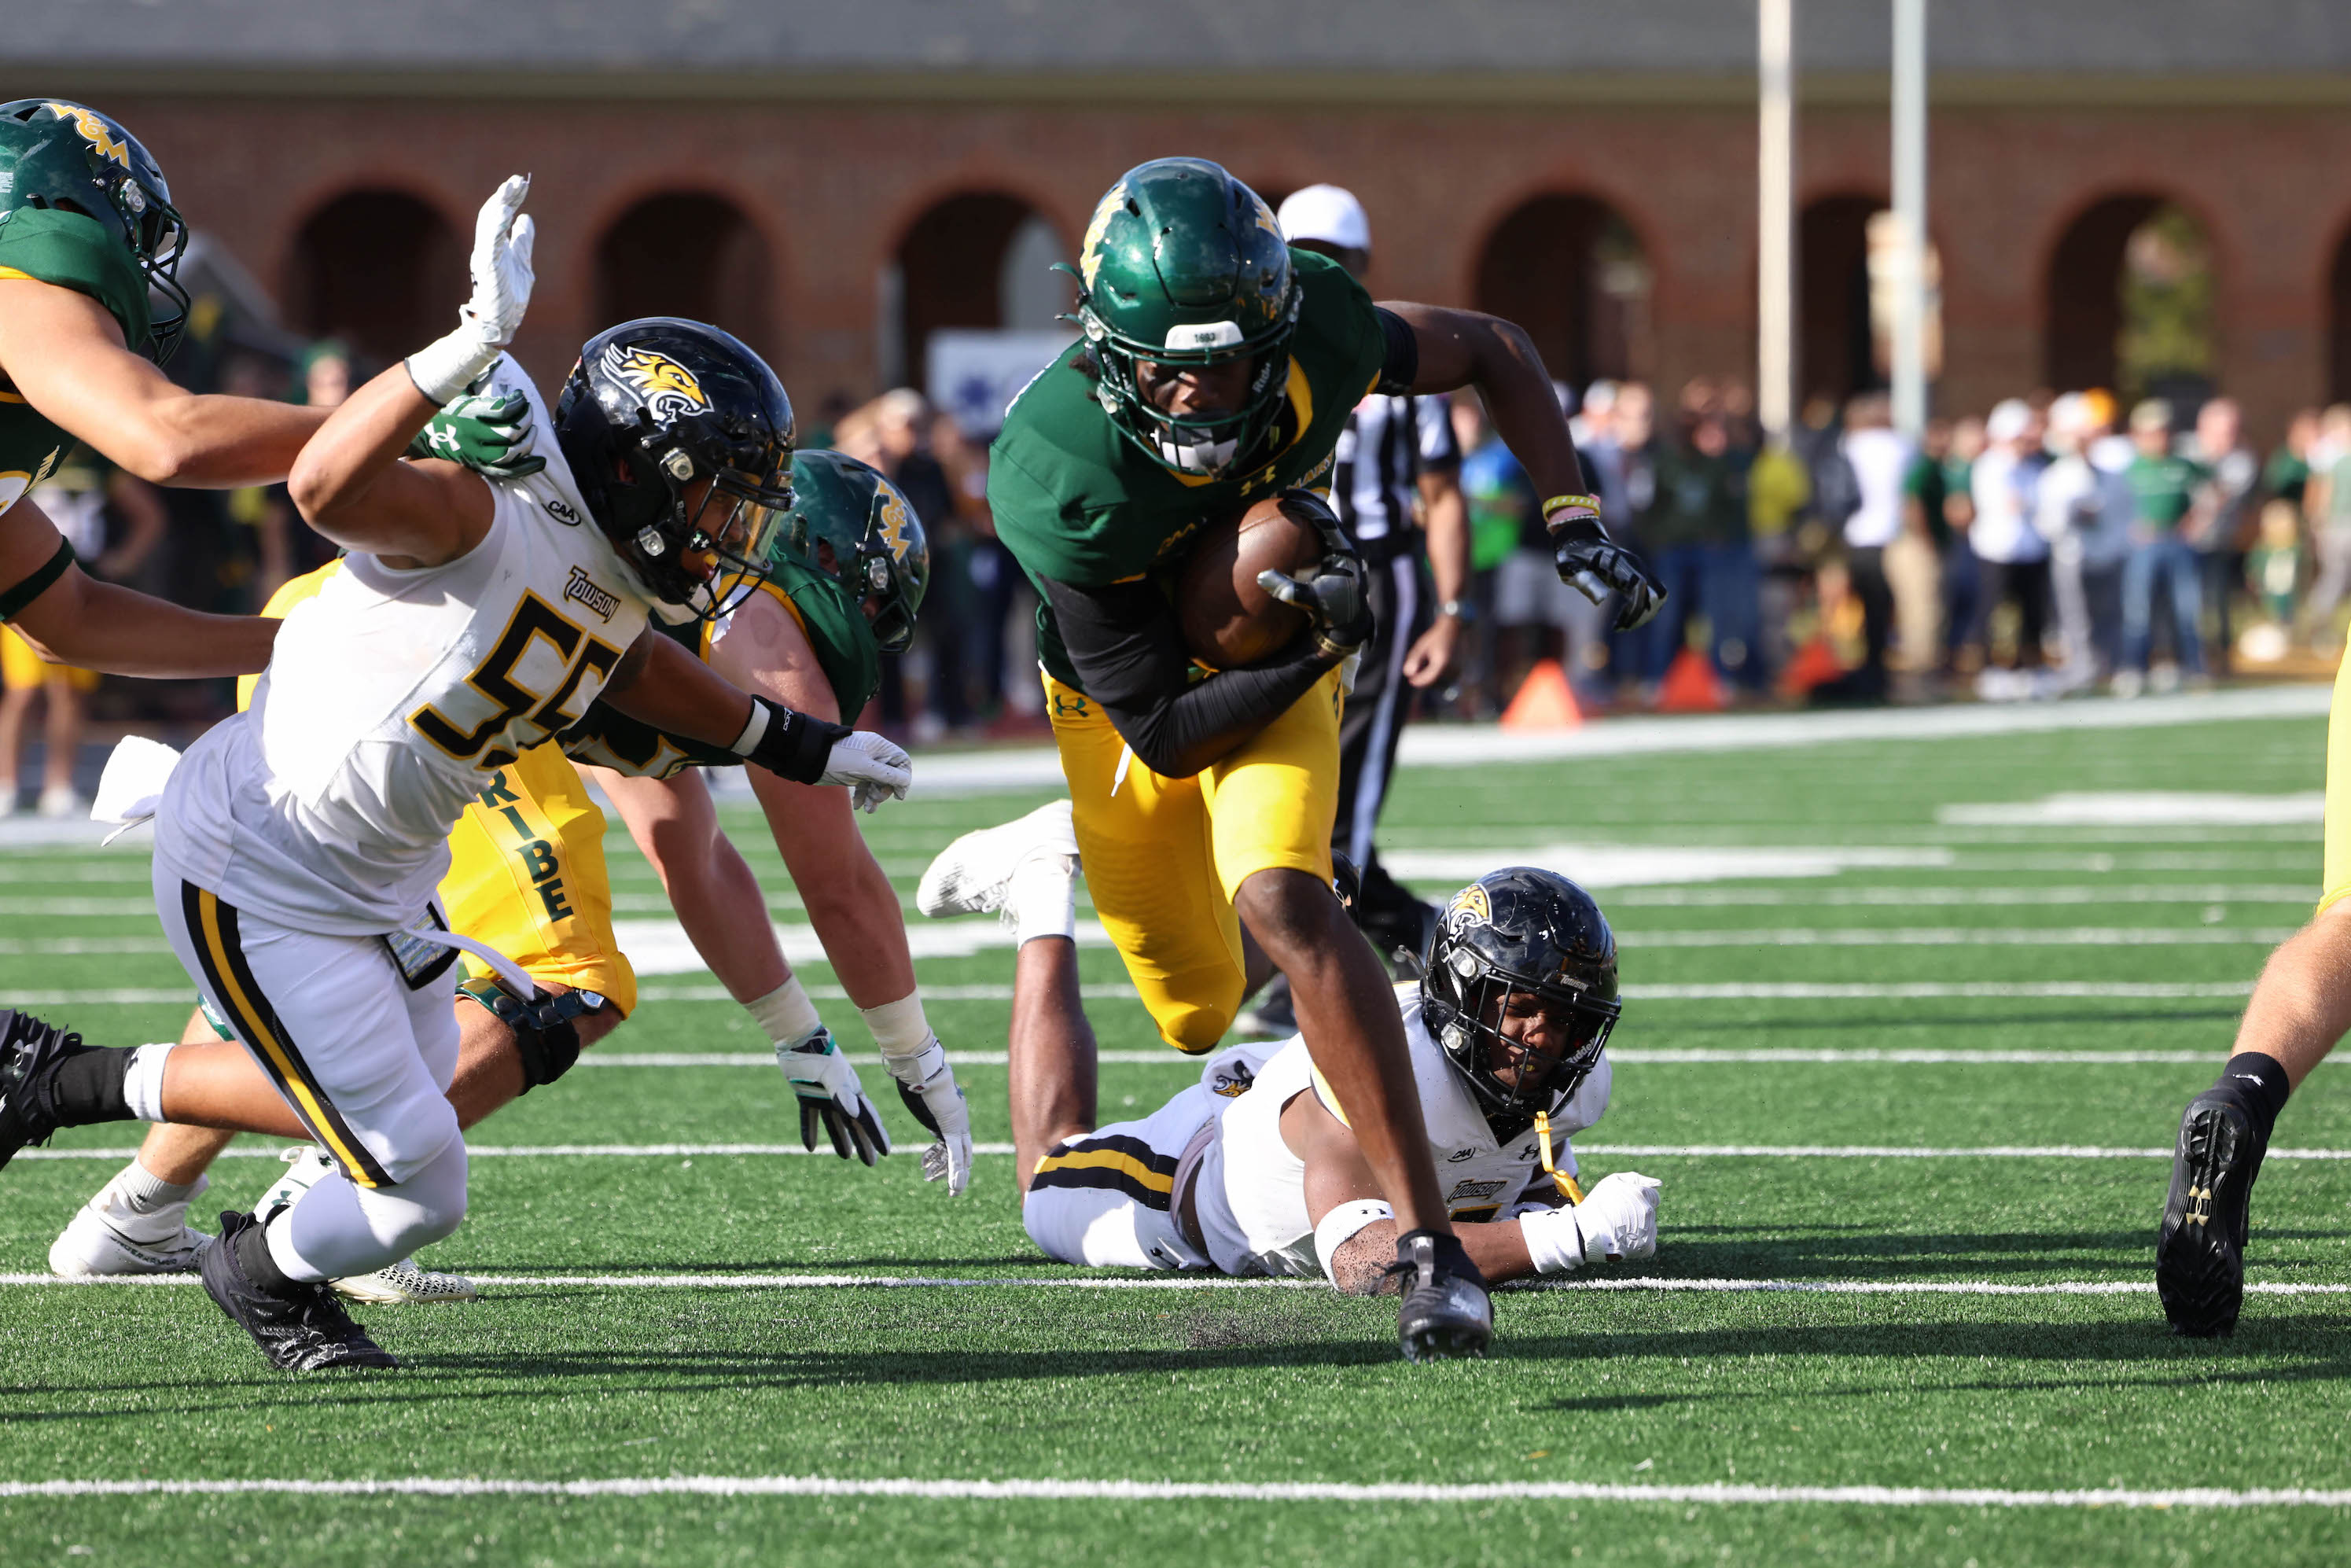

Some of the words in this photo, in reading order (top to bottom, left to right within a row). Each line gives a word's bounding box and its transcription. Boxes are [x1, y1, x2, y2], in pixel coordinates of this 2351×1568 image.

[548, 500, 575, 521] CAA
[480, 770, 574, 923] RIBE
[1452, 1148, 1471, 1159] CAA
